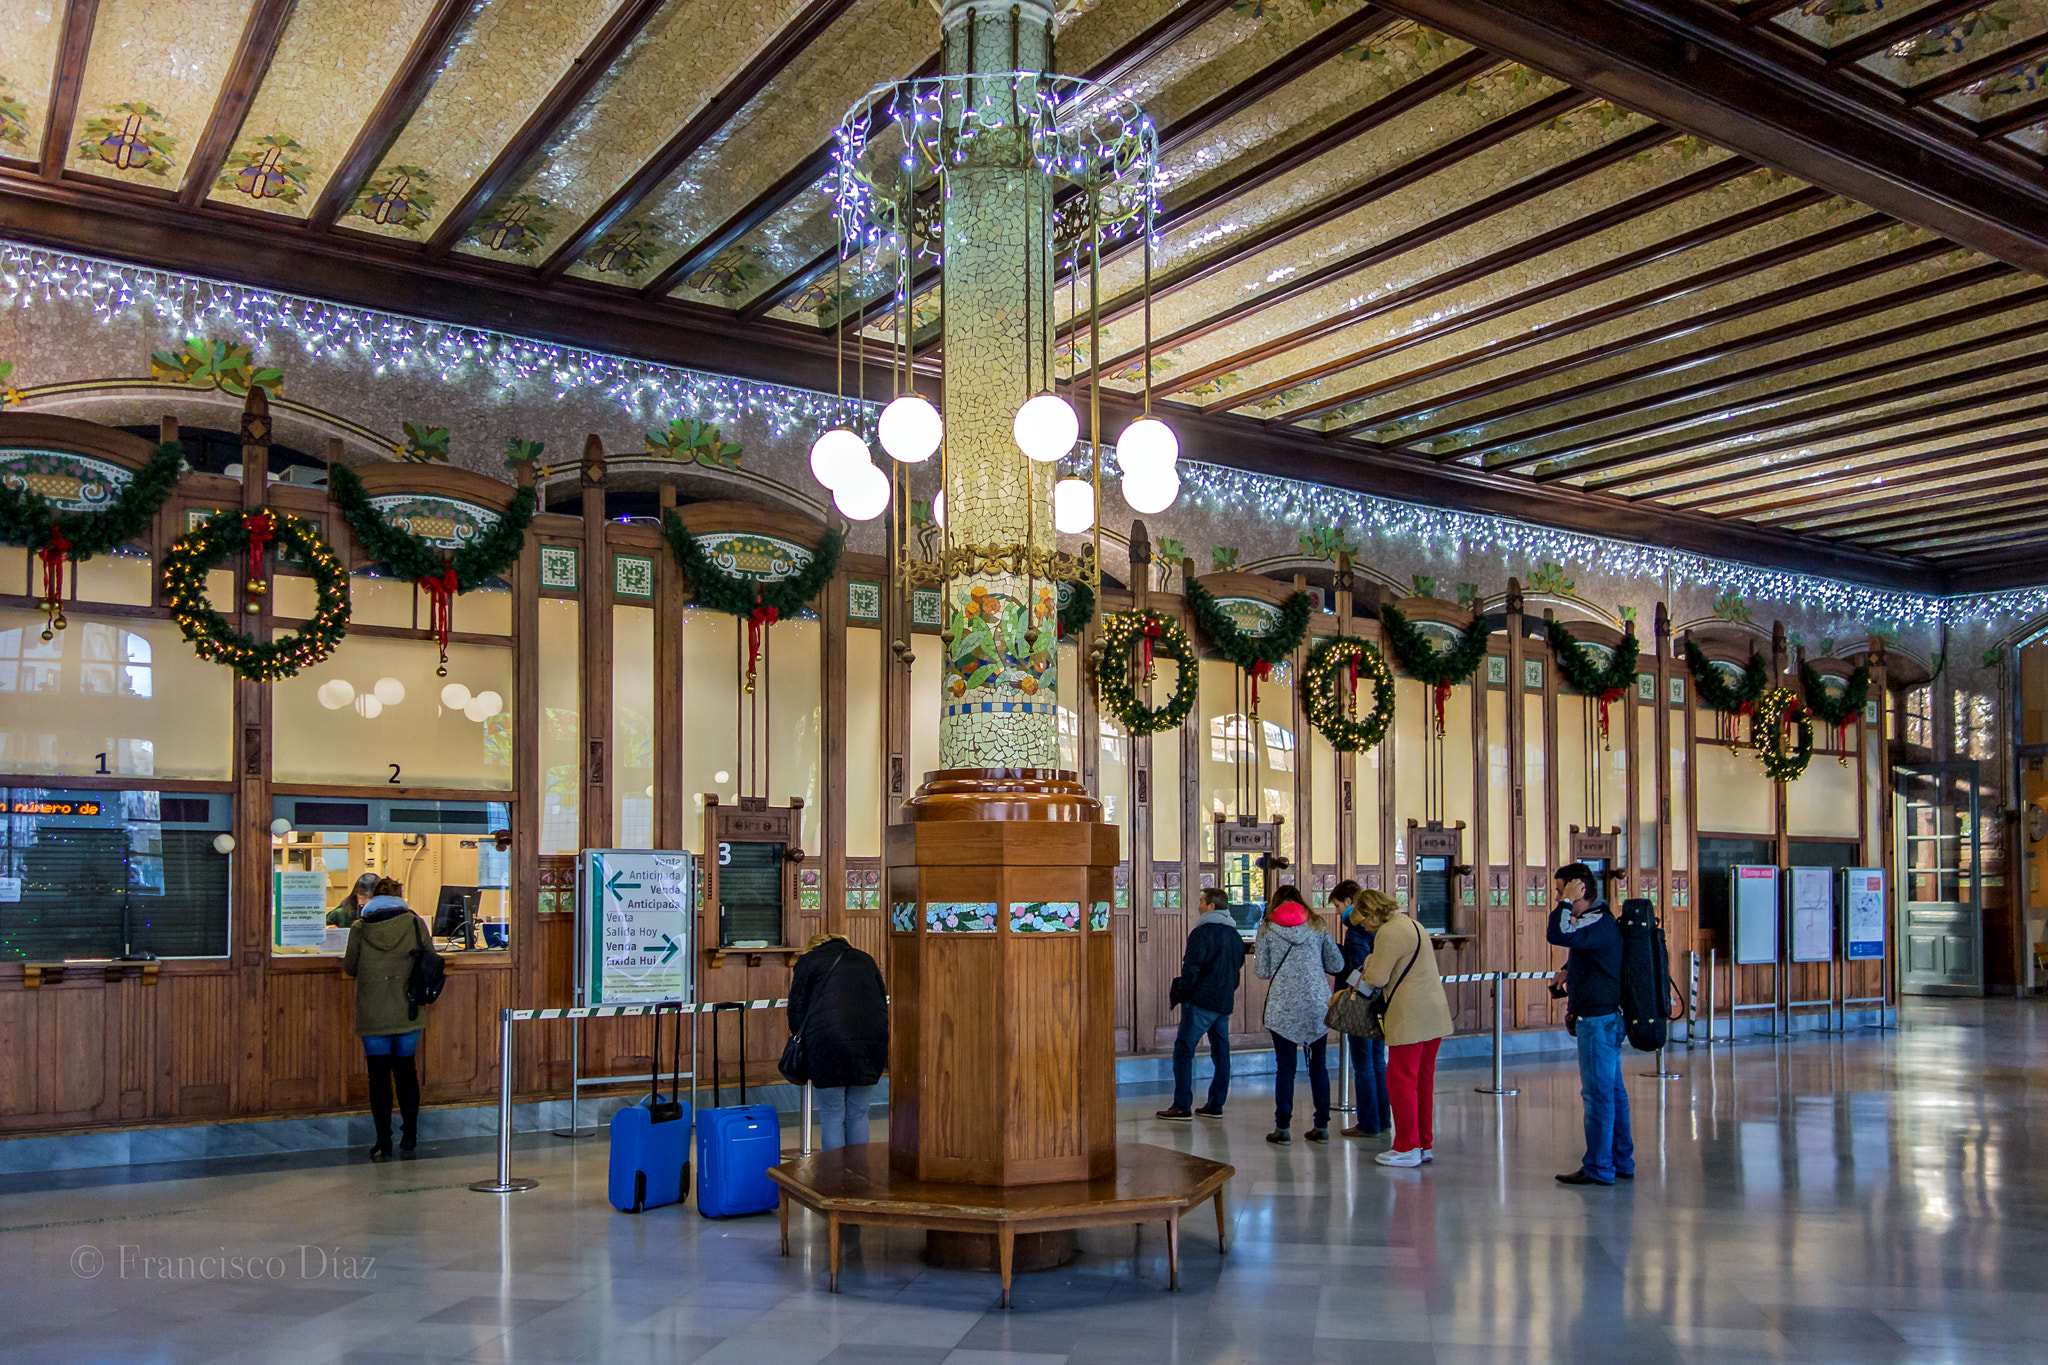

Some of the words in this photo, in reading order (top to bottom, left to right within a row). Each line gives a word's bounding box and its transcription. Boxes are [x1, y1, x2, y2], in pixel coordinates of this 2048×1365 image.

[95, 752, 111, 775] 1
[388, 763, 401, 784] 2
[79, 803, 98, 814] de
[718, 842, 732, 866] 3
[655, 857, 681, 866] Venta
[629, 870, 681, 881] Anticipada
[650, 885, 681, 895] Venda
[627, 900, 680, 910] Anticipada
[606, 913, 634, 923] Venta
[606, 927, 636, 937] Salida
[639, 928, 658, 938] Hoy
[606, 942, 637, 951] Venda
[606, 956, 636, 966] Eixida
[639, 955, 657, 965] Hui
